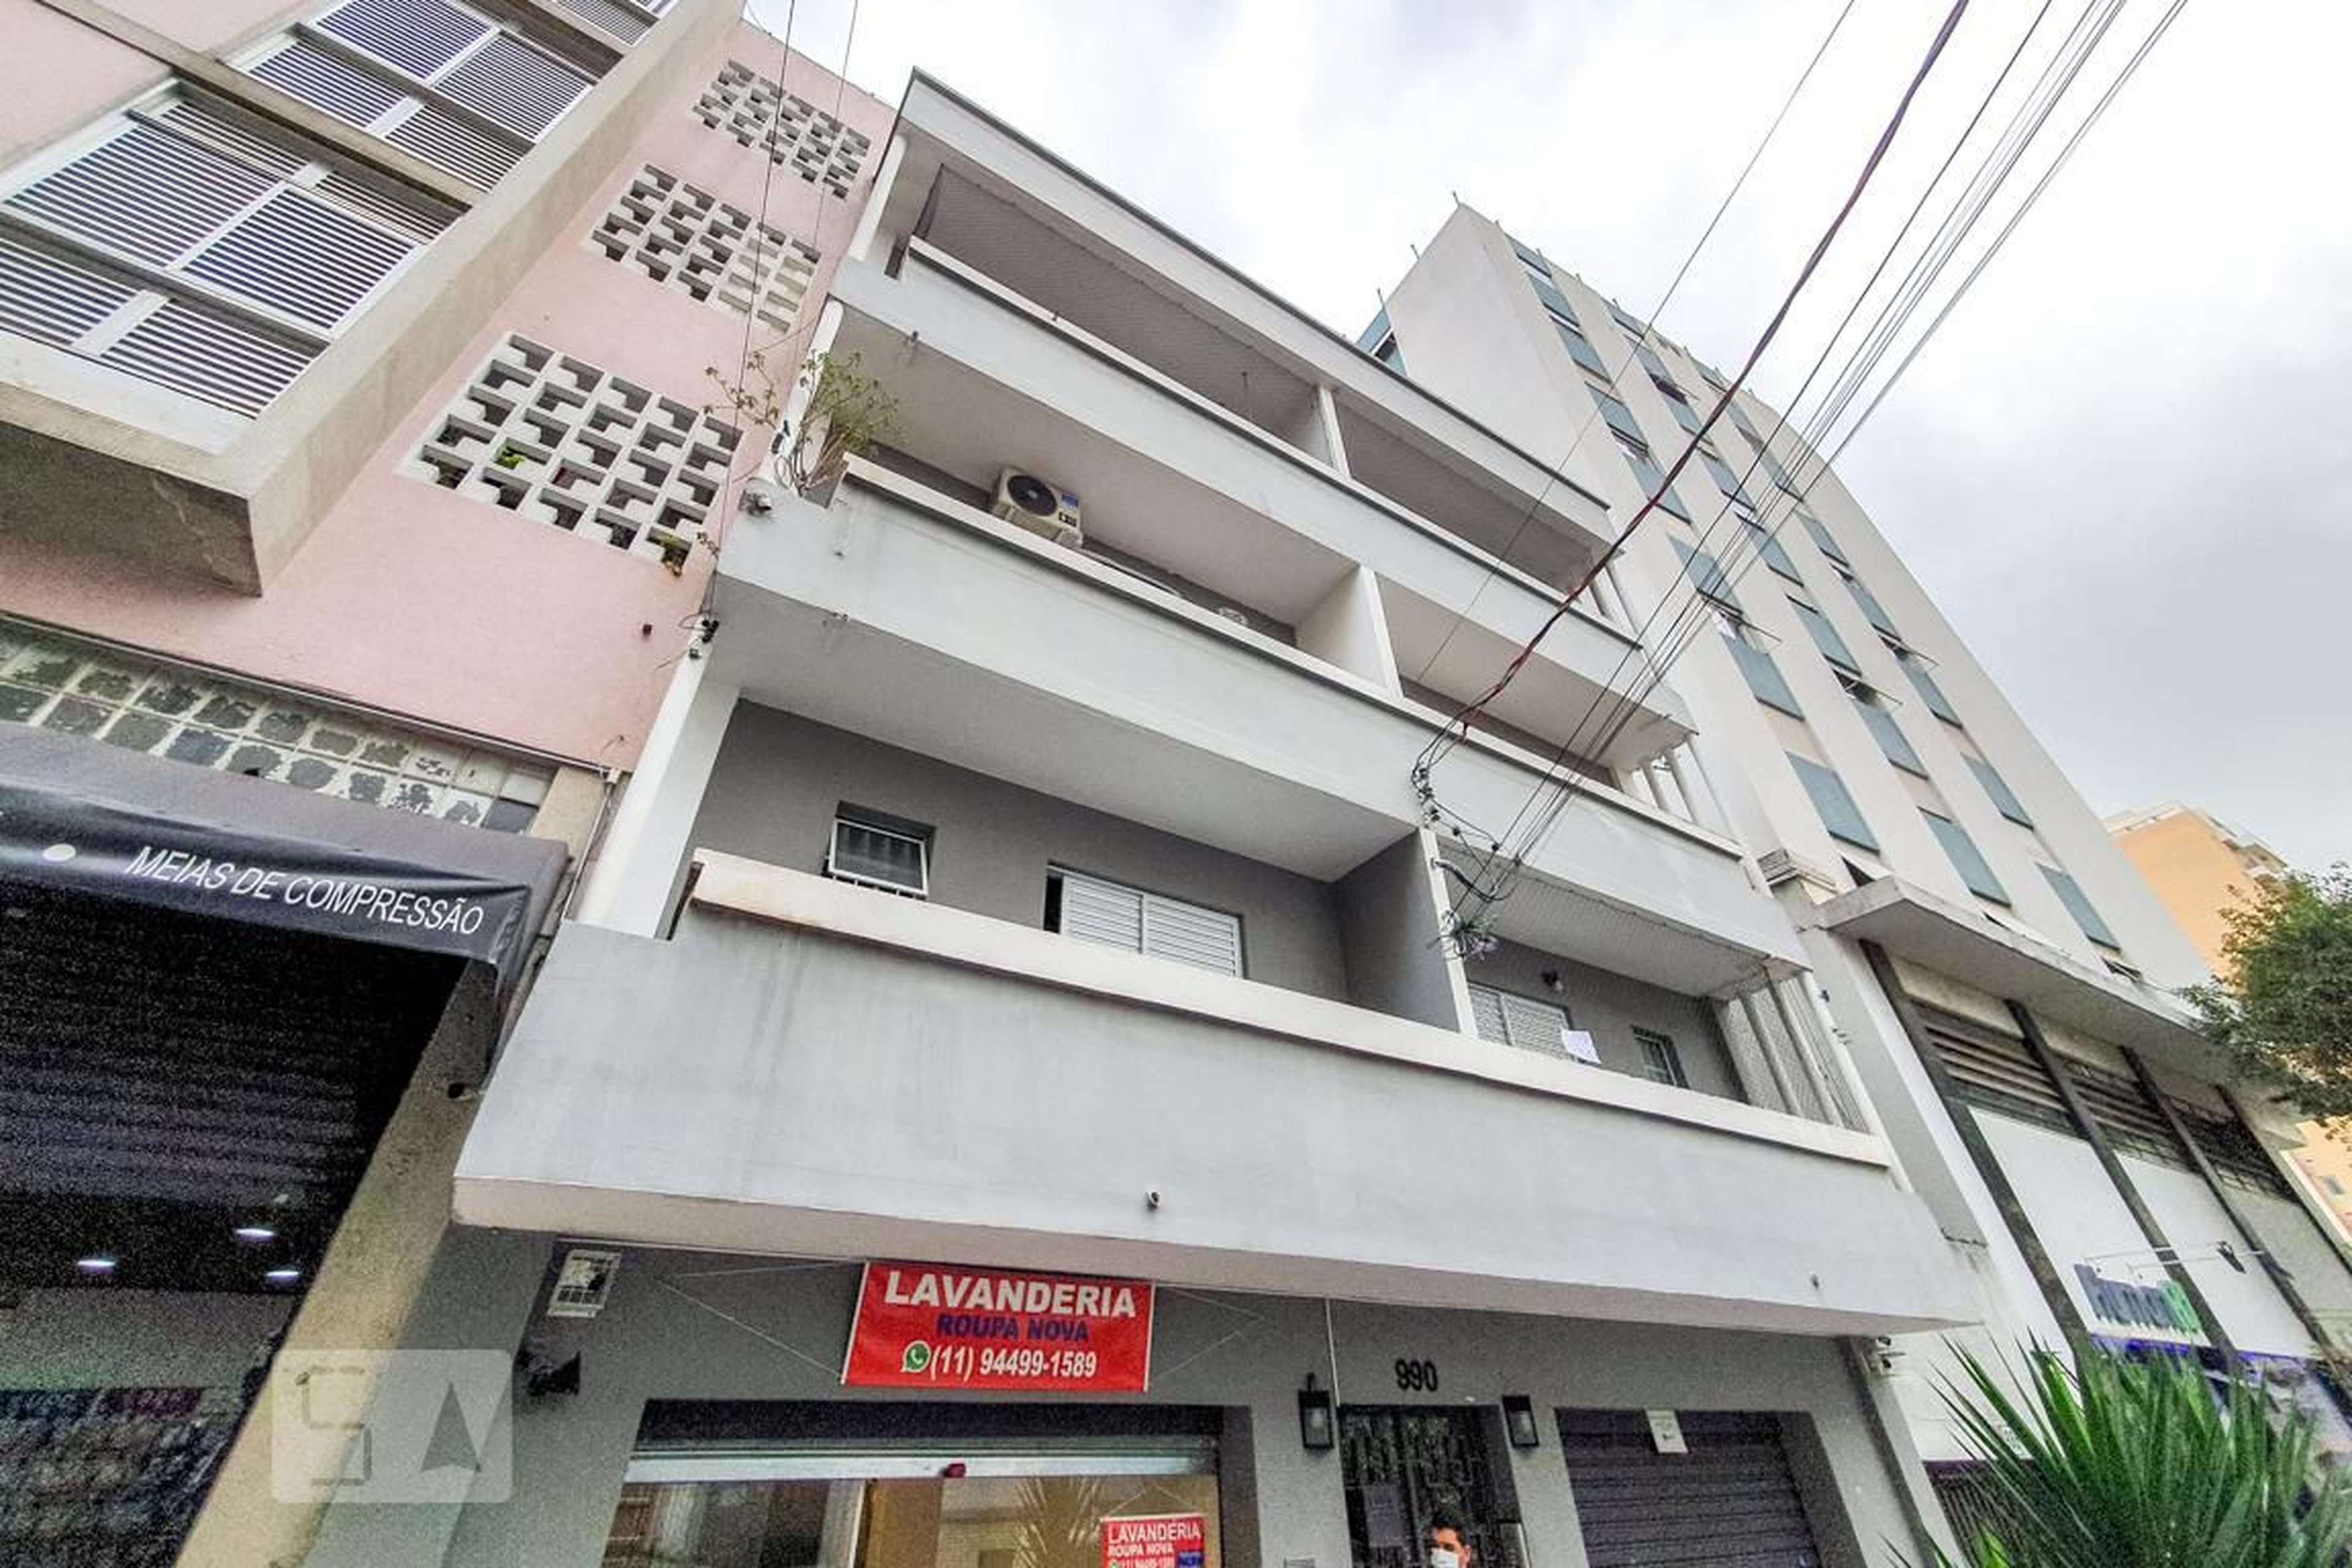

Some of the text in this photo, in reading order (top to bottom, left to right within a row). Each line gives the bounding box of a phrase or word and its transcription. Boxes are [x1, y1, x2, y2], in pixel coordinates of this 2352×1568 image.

[124, 845, 483, 934] MEIAS DE COMPRESSÃO
[884, 1270, 1136, 1319] LAVANDERIA
[937, 1314, 1089, 1343] ROUPA NOVA
[930, 1344, 1097, 1382] (11) 94499-1589
[1395, 1358, 1438, 1392] 990
[1108, 1522, 1202, 1543] LAVANDERIA
[1108, 1542, 1175, 1557] ROUPA NOVA
